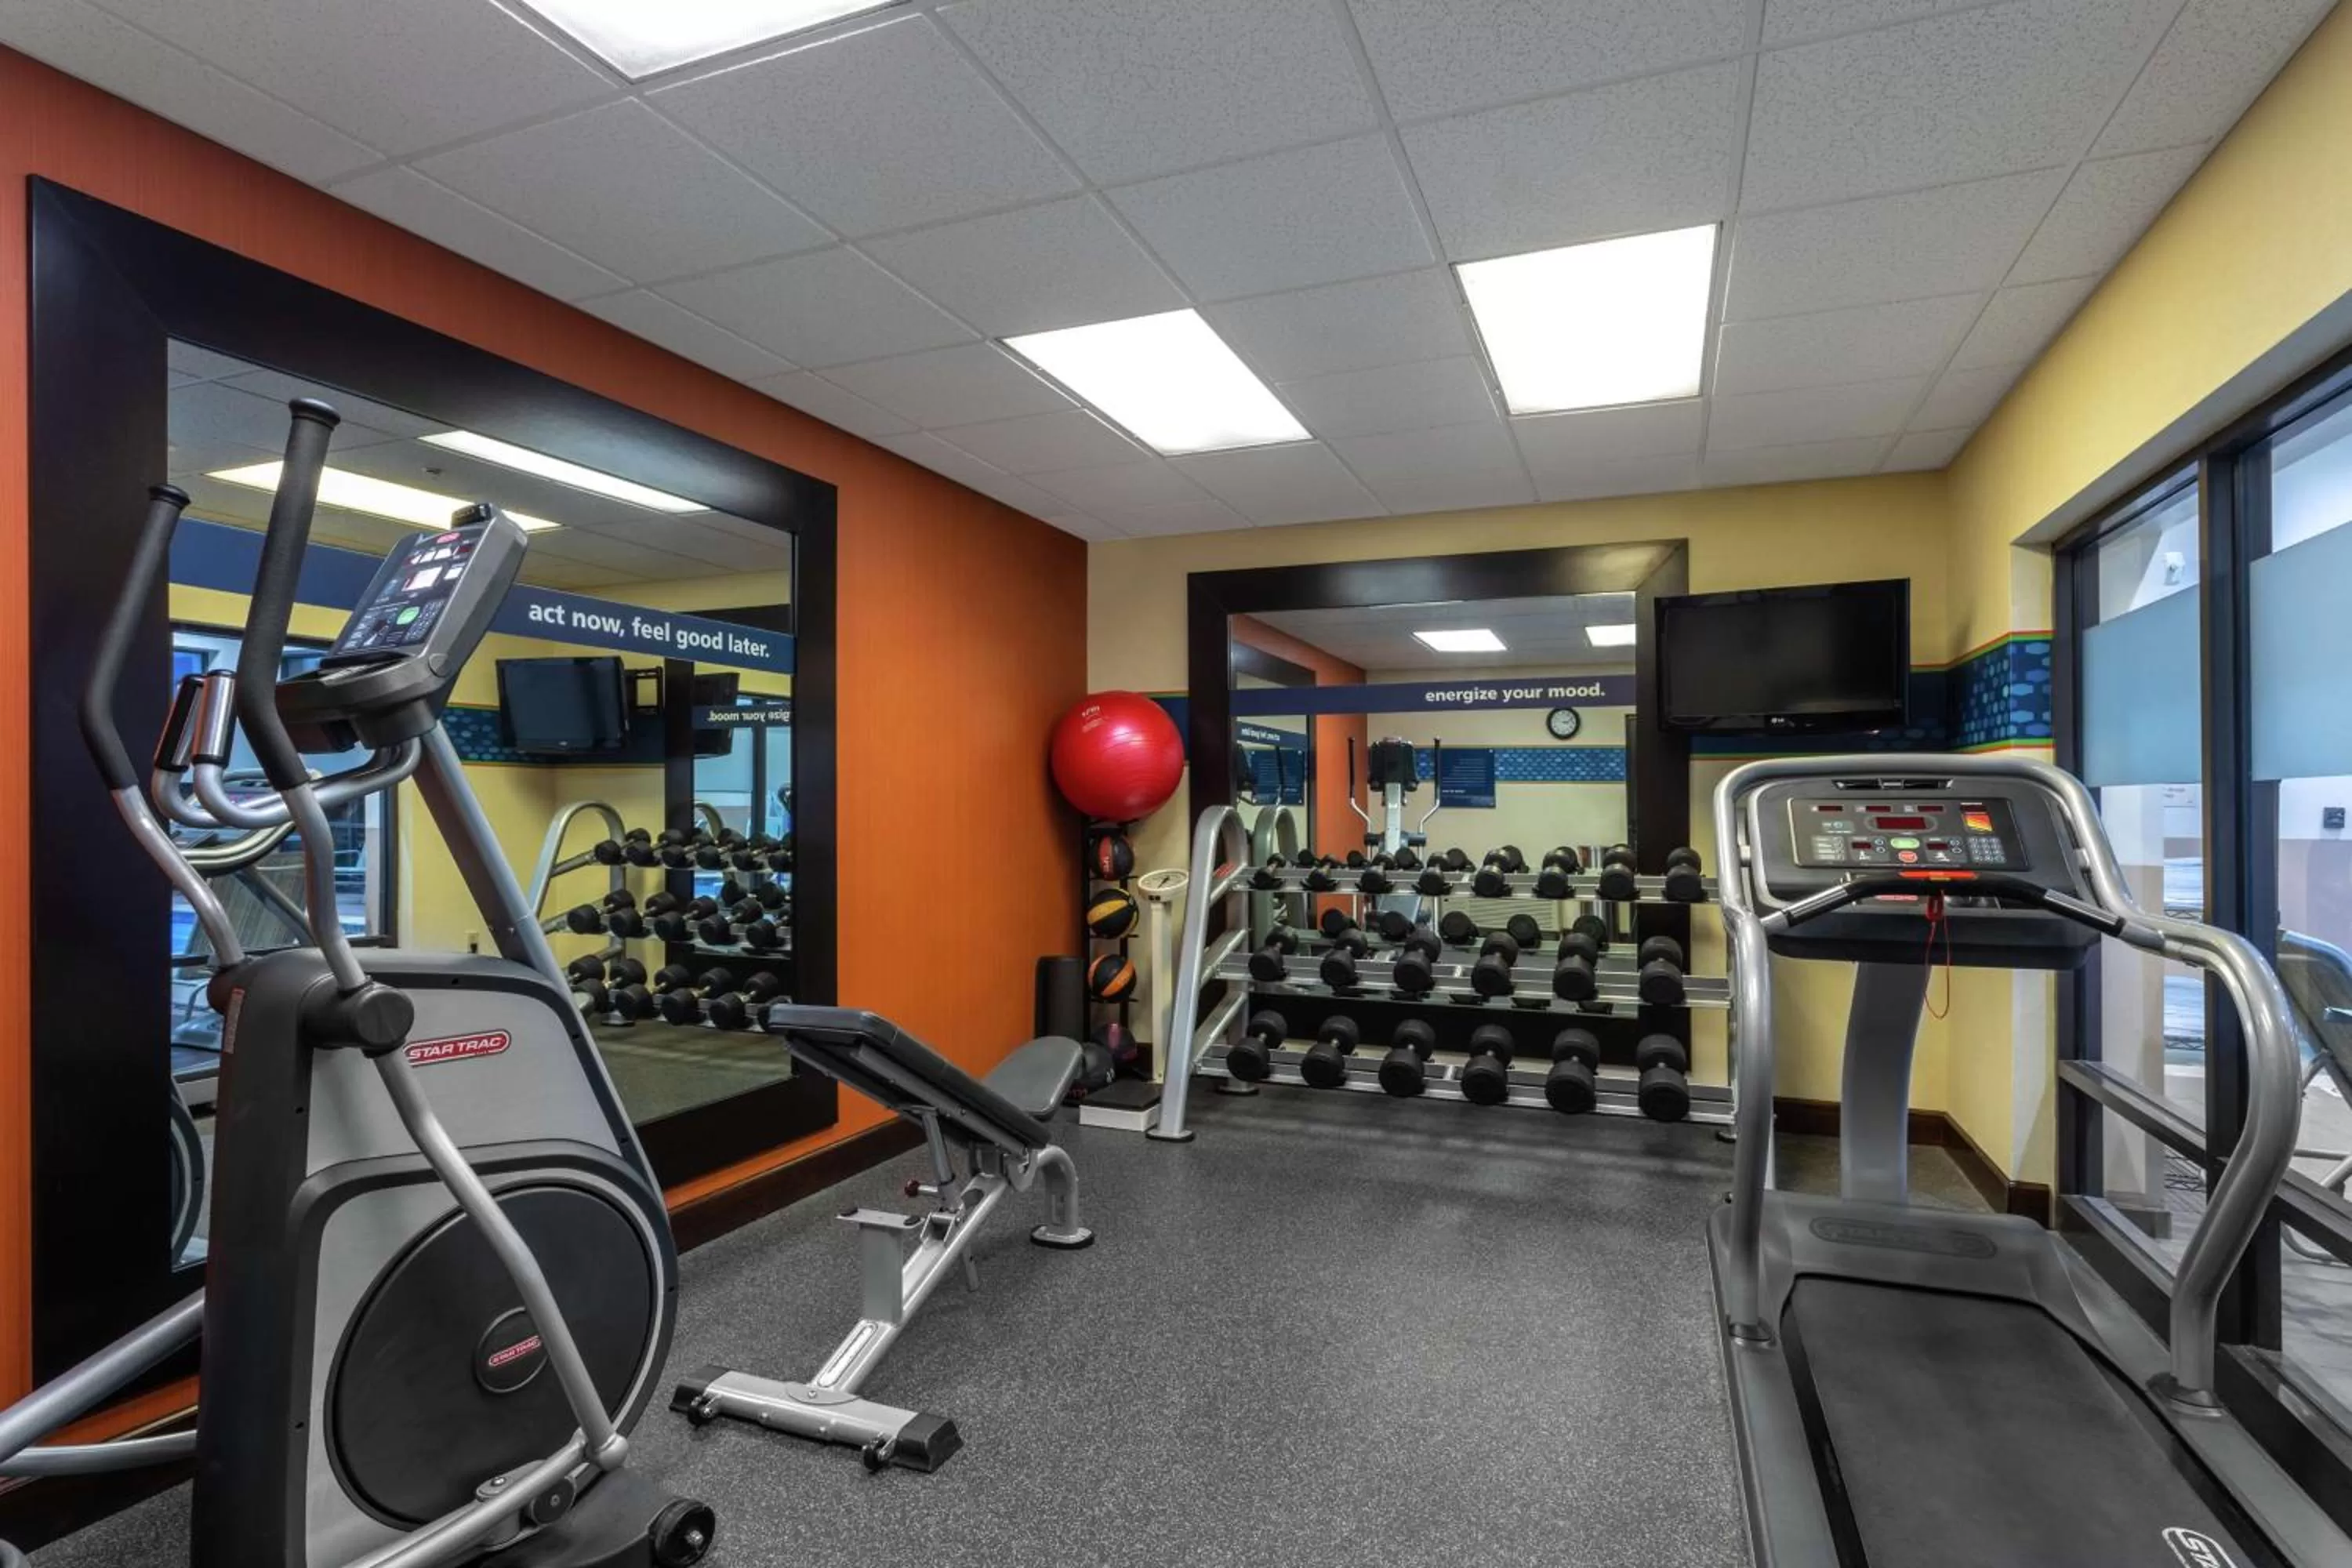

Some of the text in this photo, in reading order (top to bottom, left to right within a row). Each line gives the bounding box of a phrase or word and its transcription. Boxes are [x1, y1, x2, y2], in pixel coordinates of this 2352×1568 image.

[529, 604, 770, 658] act now, feel good later.
[1425, 681, 1606, 704] energize your mood.
[409, 1036, 503, 1059] STAR TRAC
